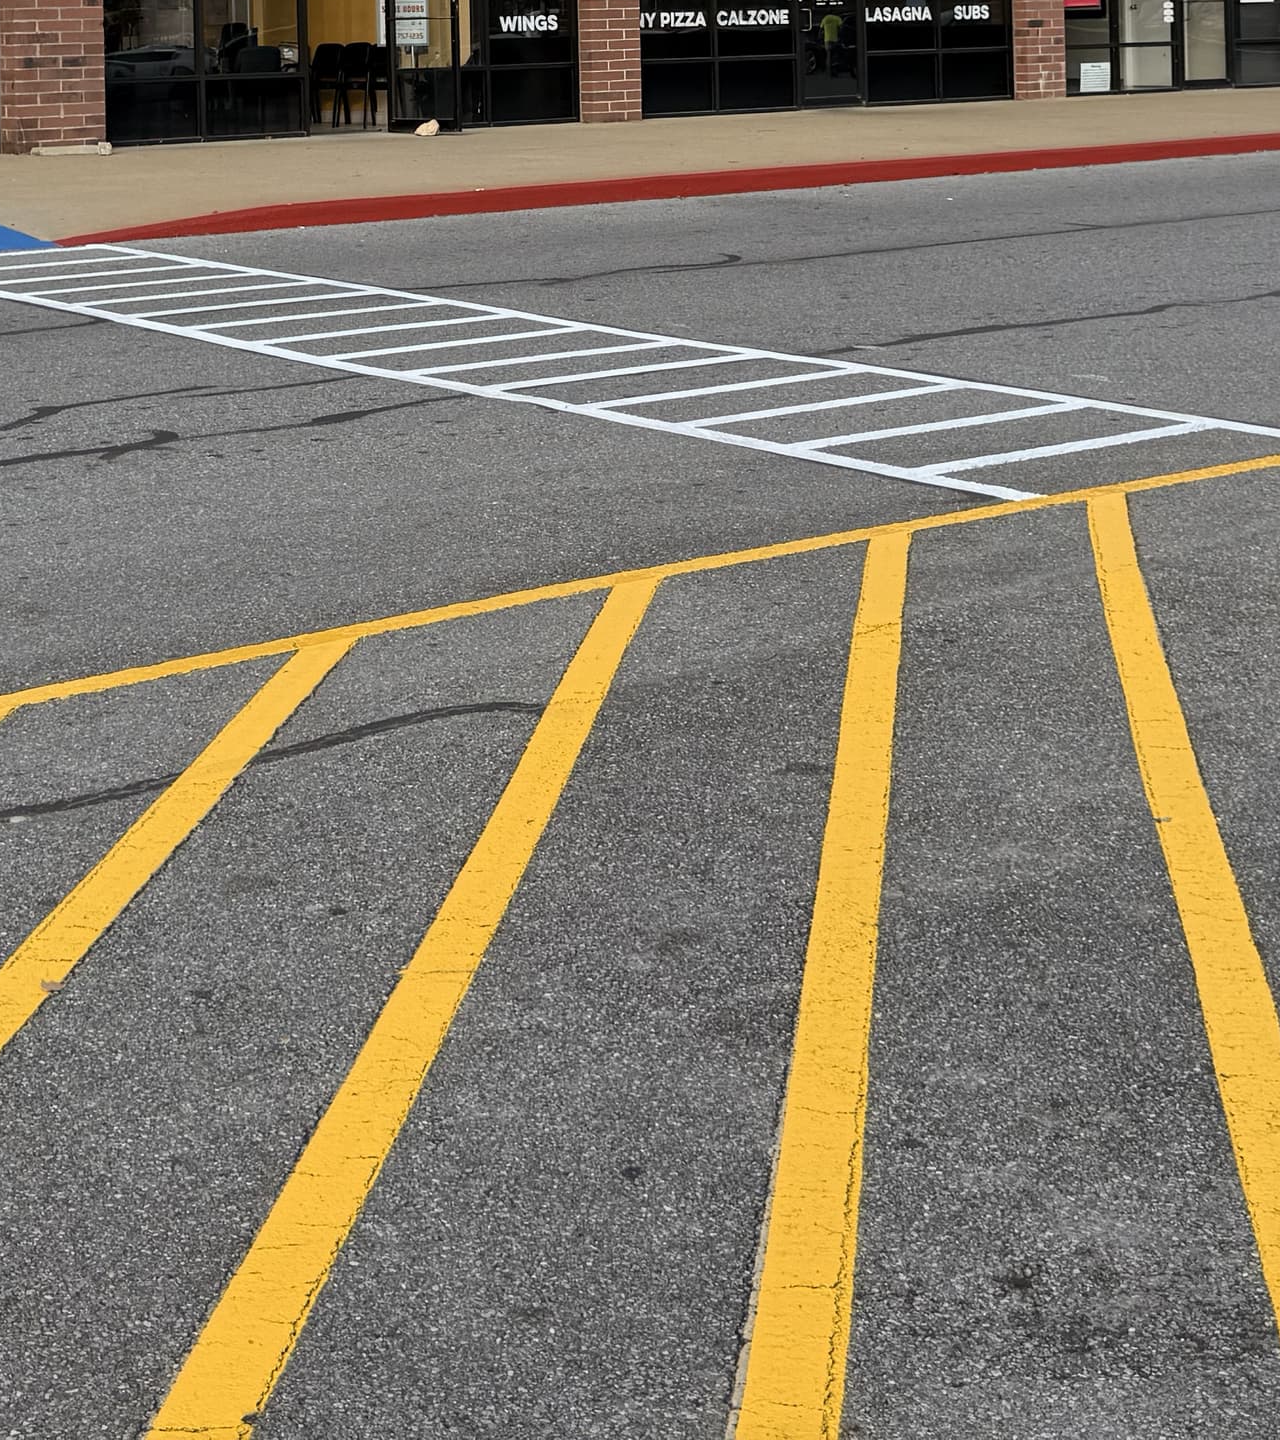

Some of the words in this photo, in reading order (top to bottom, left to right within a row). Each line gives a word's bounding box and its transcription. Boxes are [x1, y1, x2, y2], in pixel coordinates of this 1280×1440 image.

[660, 11, 707, 27] PIZZA
[716, 9, 790, 26] CALZONE
[865, 6, 933, 22] LASAGNA
[953, 5, 990, 20] SUBS
[499, 14, 559, 32] WINGS
